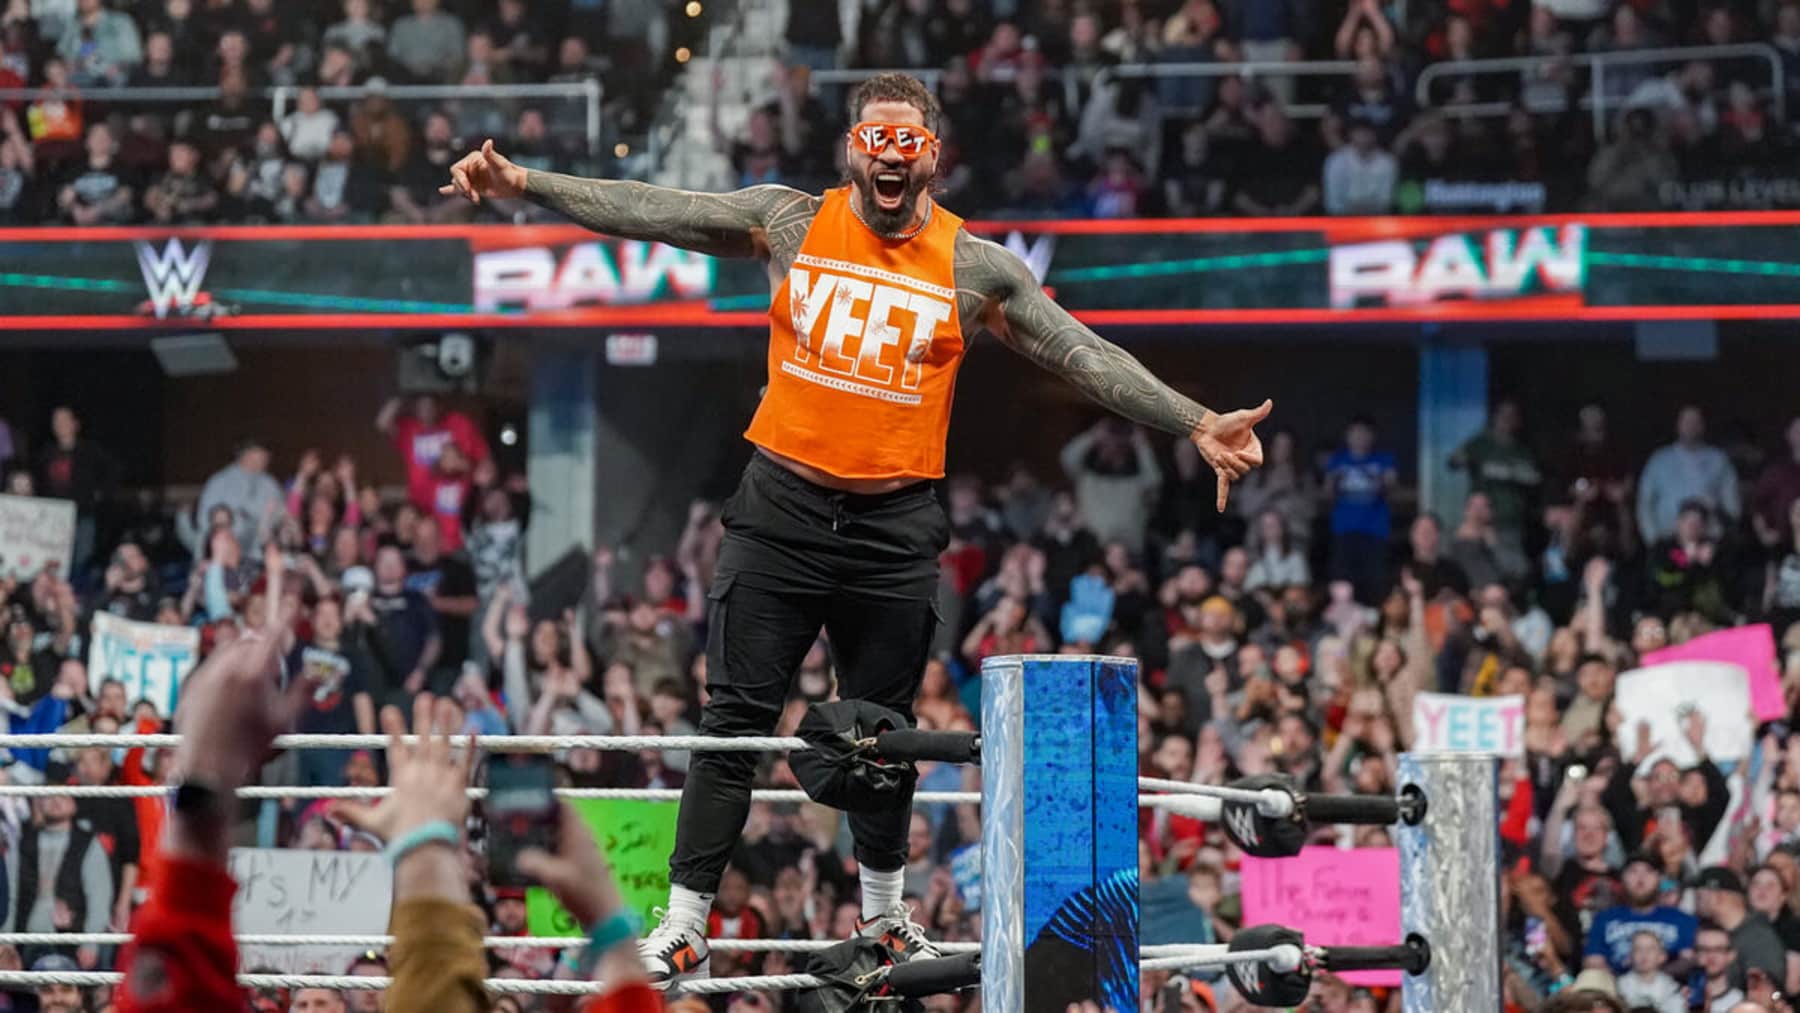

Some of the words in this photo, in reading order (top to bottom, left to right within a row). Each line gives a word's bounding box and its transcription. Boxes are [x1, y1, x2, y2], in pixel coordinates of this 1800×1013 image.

[859, 125, 926, 153] YEET
[473, 238, 718, 314] RAW
[1330, 222, 1590, 311] RAW
[789, 267, 953, 391] YEET
[1418, 700, 1526, 750] YEET
[308, 855, 370, 904] MY
